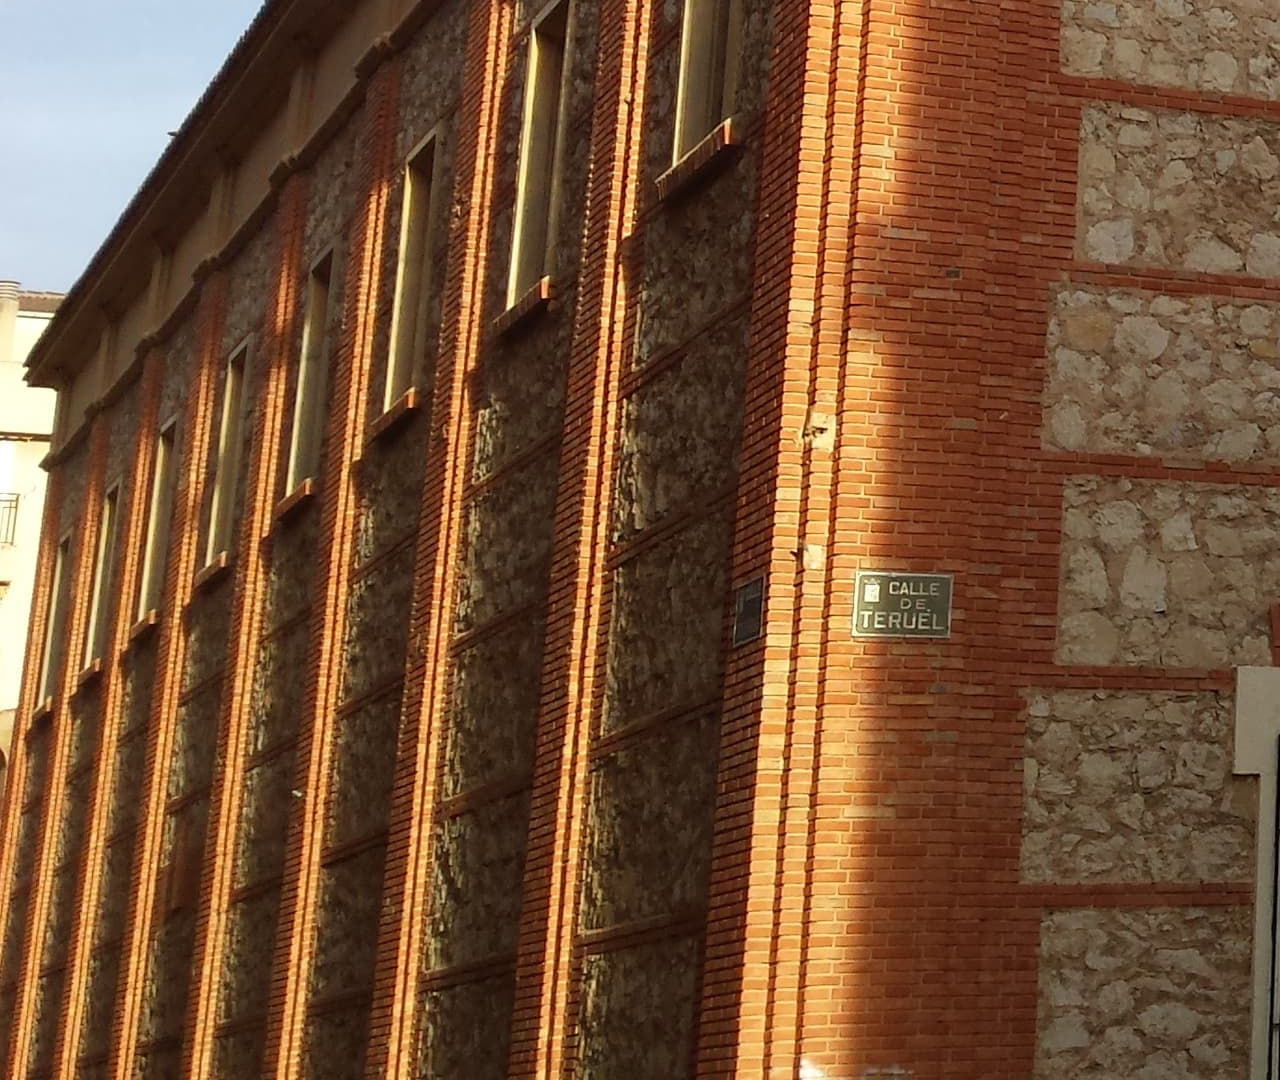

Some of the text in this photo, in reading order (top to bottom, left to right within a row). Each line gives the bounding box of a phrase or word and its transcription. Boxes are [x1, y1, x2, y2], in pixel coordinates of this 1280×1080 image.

[888, 581, 940, 596] CALLE
[900, 598, 927, 610] DE
[859, 611, 945, 630] TERUEL
